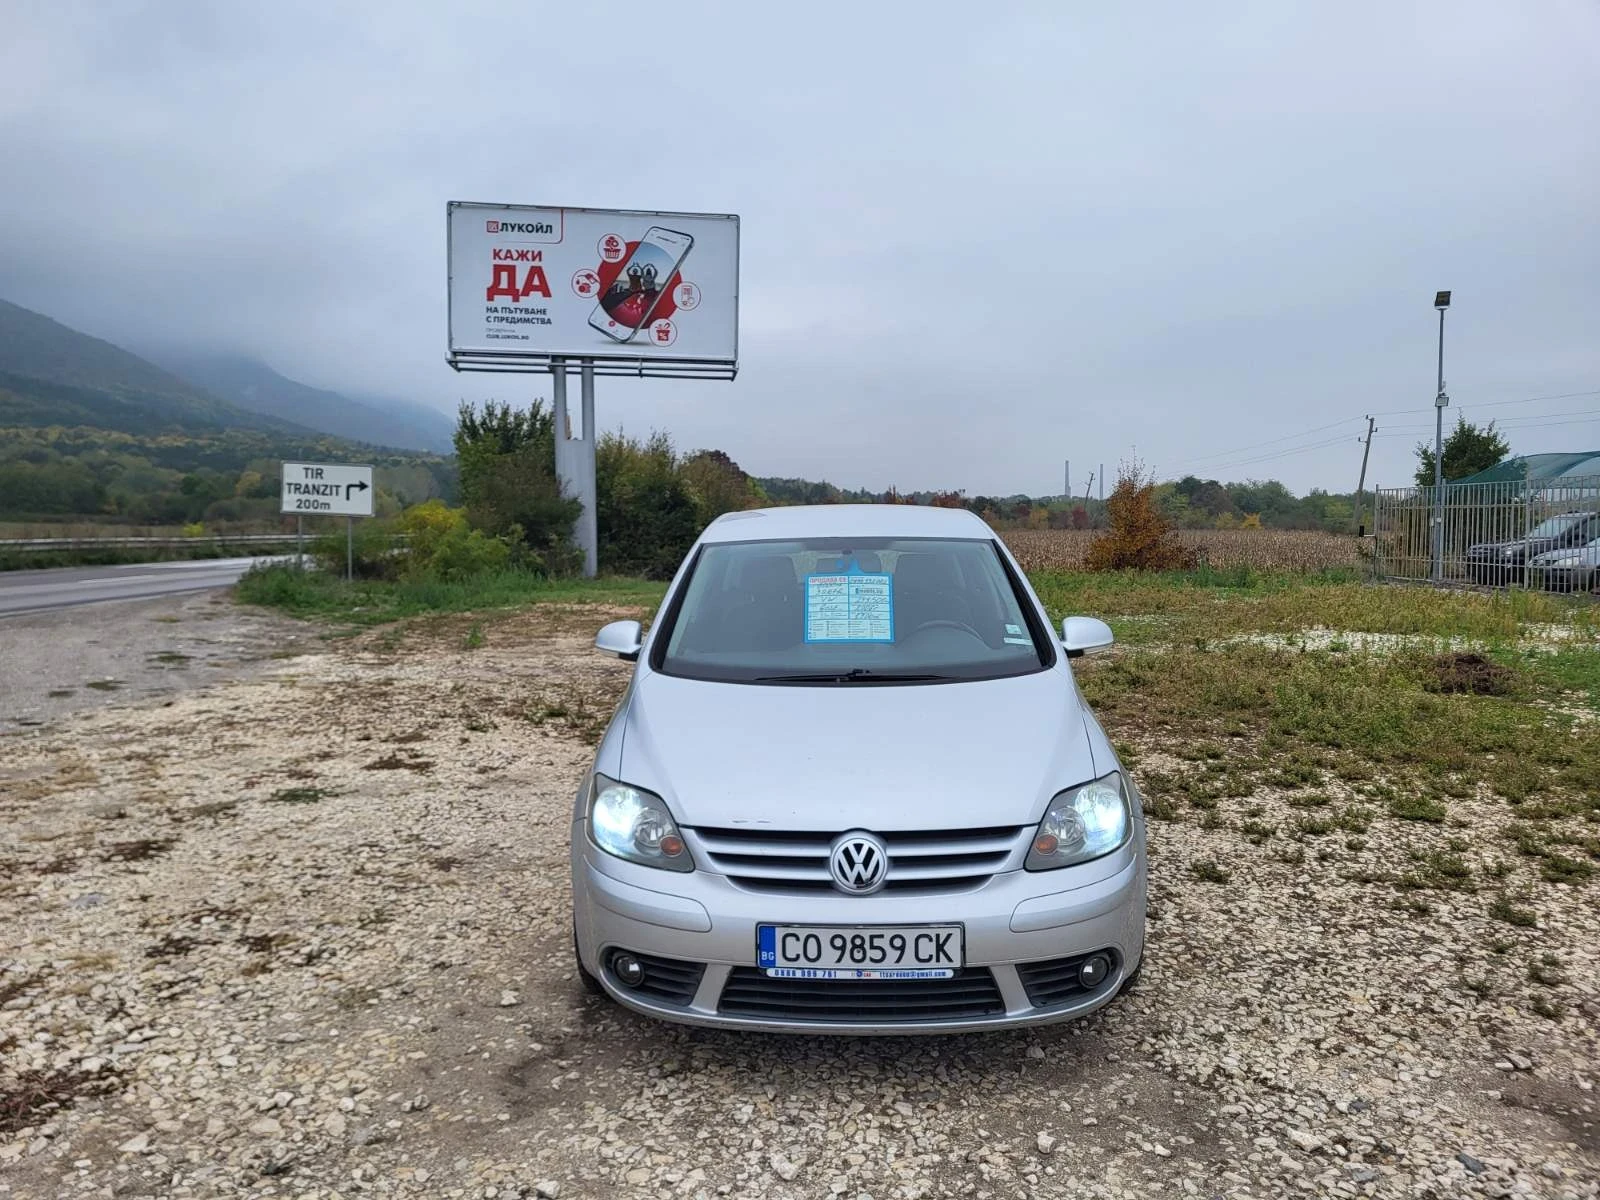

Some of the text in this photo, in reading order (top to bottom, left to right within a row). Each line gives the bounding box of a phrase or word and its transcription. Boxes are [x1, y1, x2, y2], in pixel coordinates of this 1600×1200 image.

[500, 222, 553, 234] ЛУКОЙЛ
[493, 248, 542, 262] КАЖИ
[486, 264, 552, 302] ДА
[486, 306, 547, 315] НА ПЪТУВАНЕ
[494, 316, 552, 325] ПРЕДИМСТВА
[304, 467, 324, 479] TIR
[286, 483, 342, 496] TRANZIT
[296, 499, 331, 510] 200m
[833, 838, 886, 890] VW
[781, 933, 954, 964] CO 9859 CK
[761, 951, 774, 960] BG
